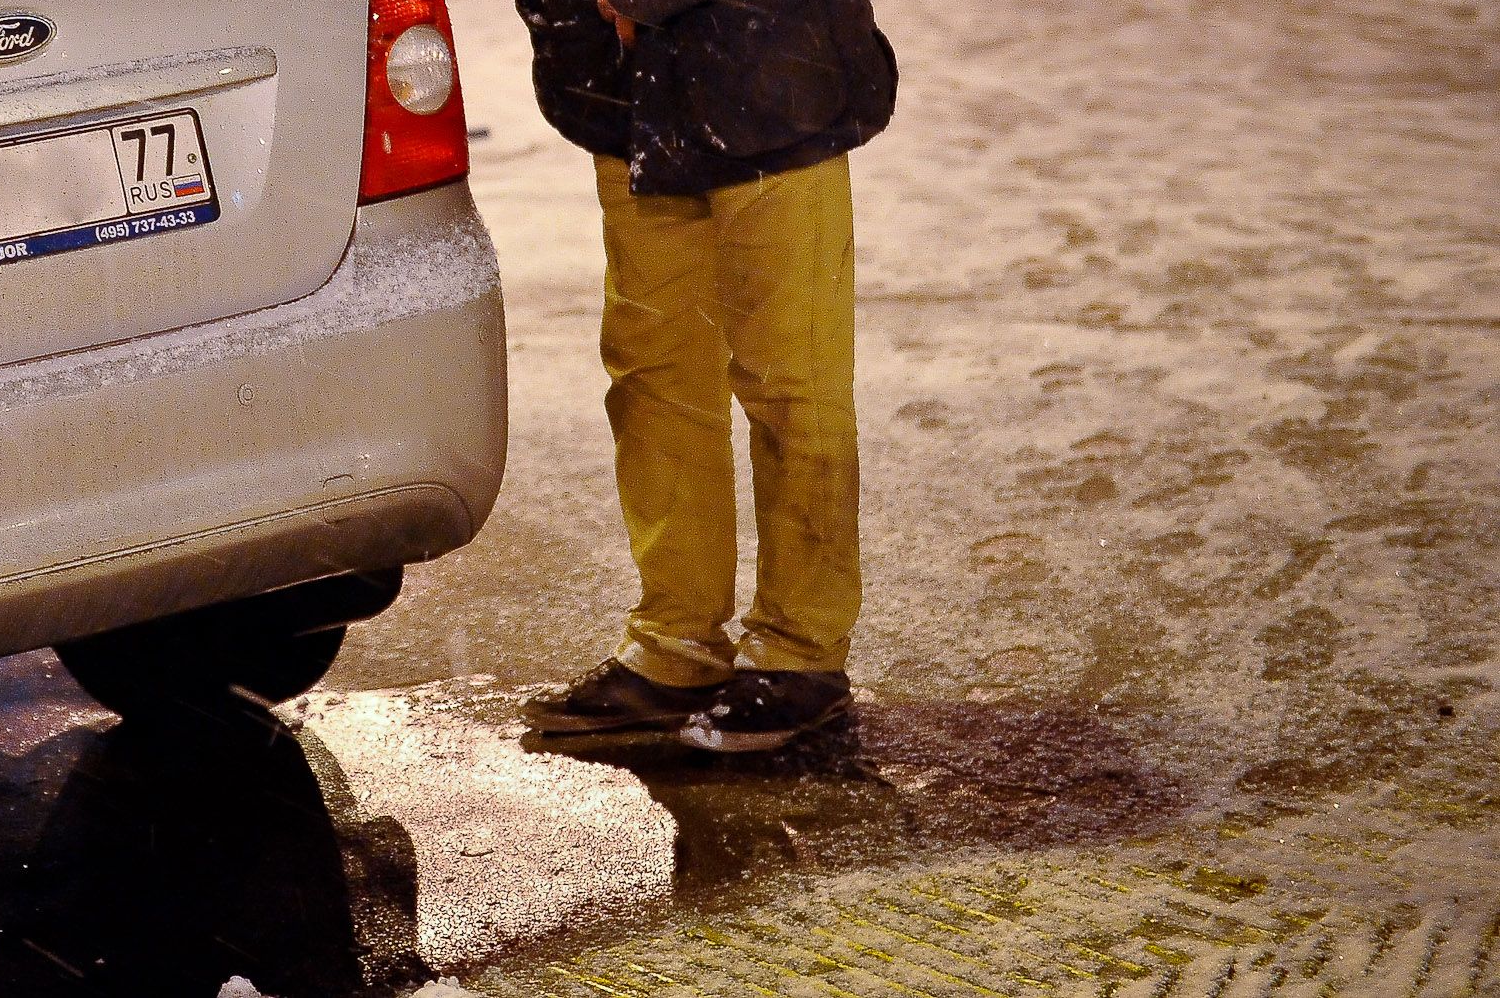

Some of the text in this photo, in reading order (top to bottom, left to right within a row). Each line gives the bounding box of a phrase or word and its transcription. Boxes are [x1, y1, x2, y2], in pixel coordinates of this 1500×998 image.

[120, 123, 176, 182] 77
[130, 181, 173, 205] RUS
[95, 221, 130, 242] (495)
[131, 210, 196, 234] 737-43-33
